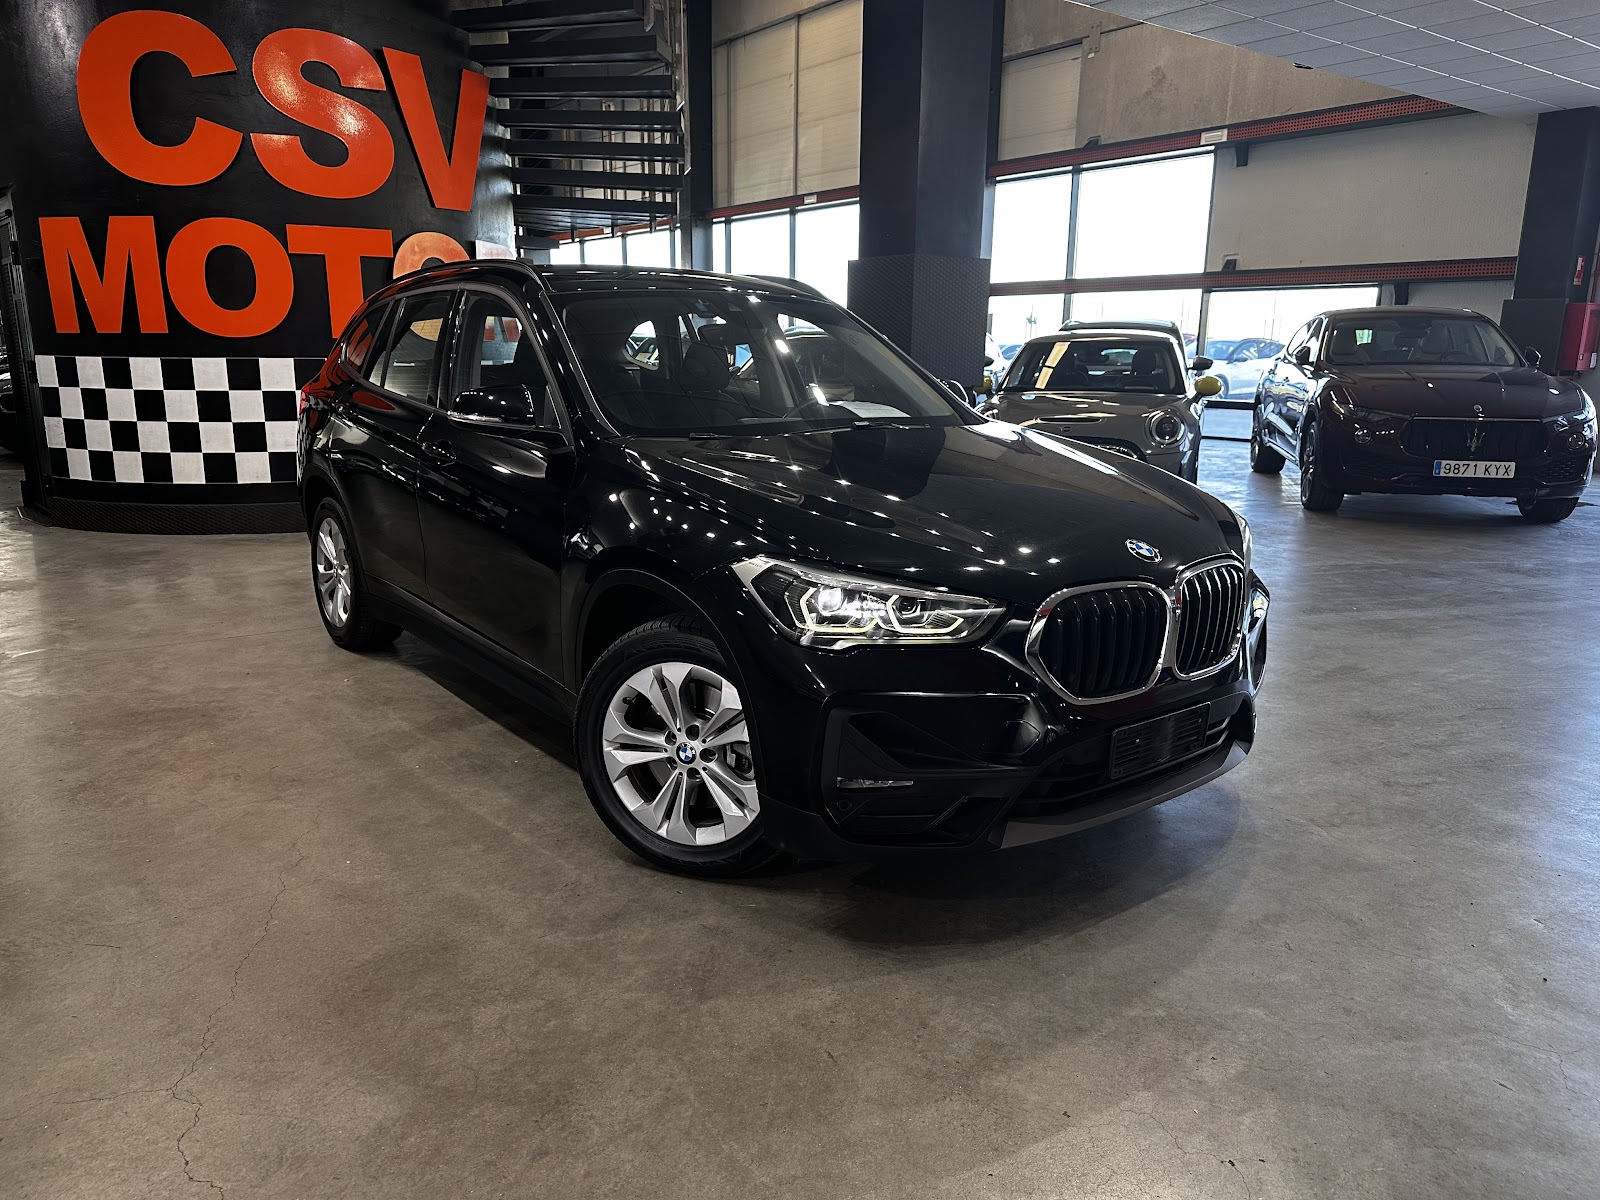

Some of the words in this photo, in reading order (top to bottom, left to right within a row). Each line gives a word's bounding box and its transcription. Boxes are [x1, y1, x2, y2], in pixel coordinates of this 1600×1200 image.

[77, 10, 489, 212] CSV
[1443, 463, 1478, 476] 9871
[1483, 464, 1511, 476] KYX
